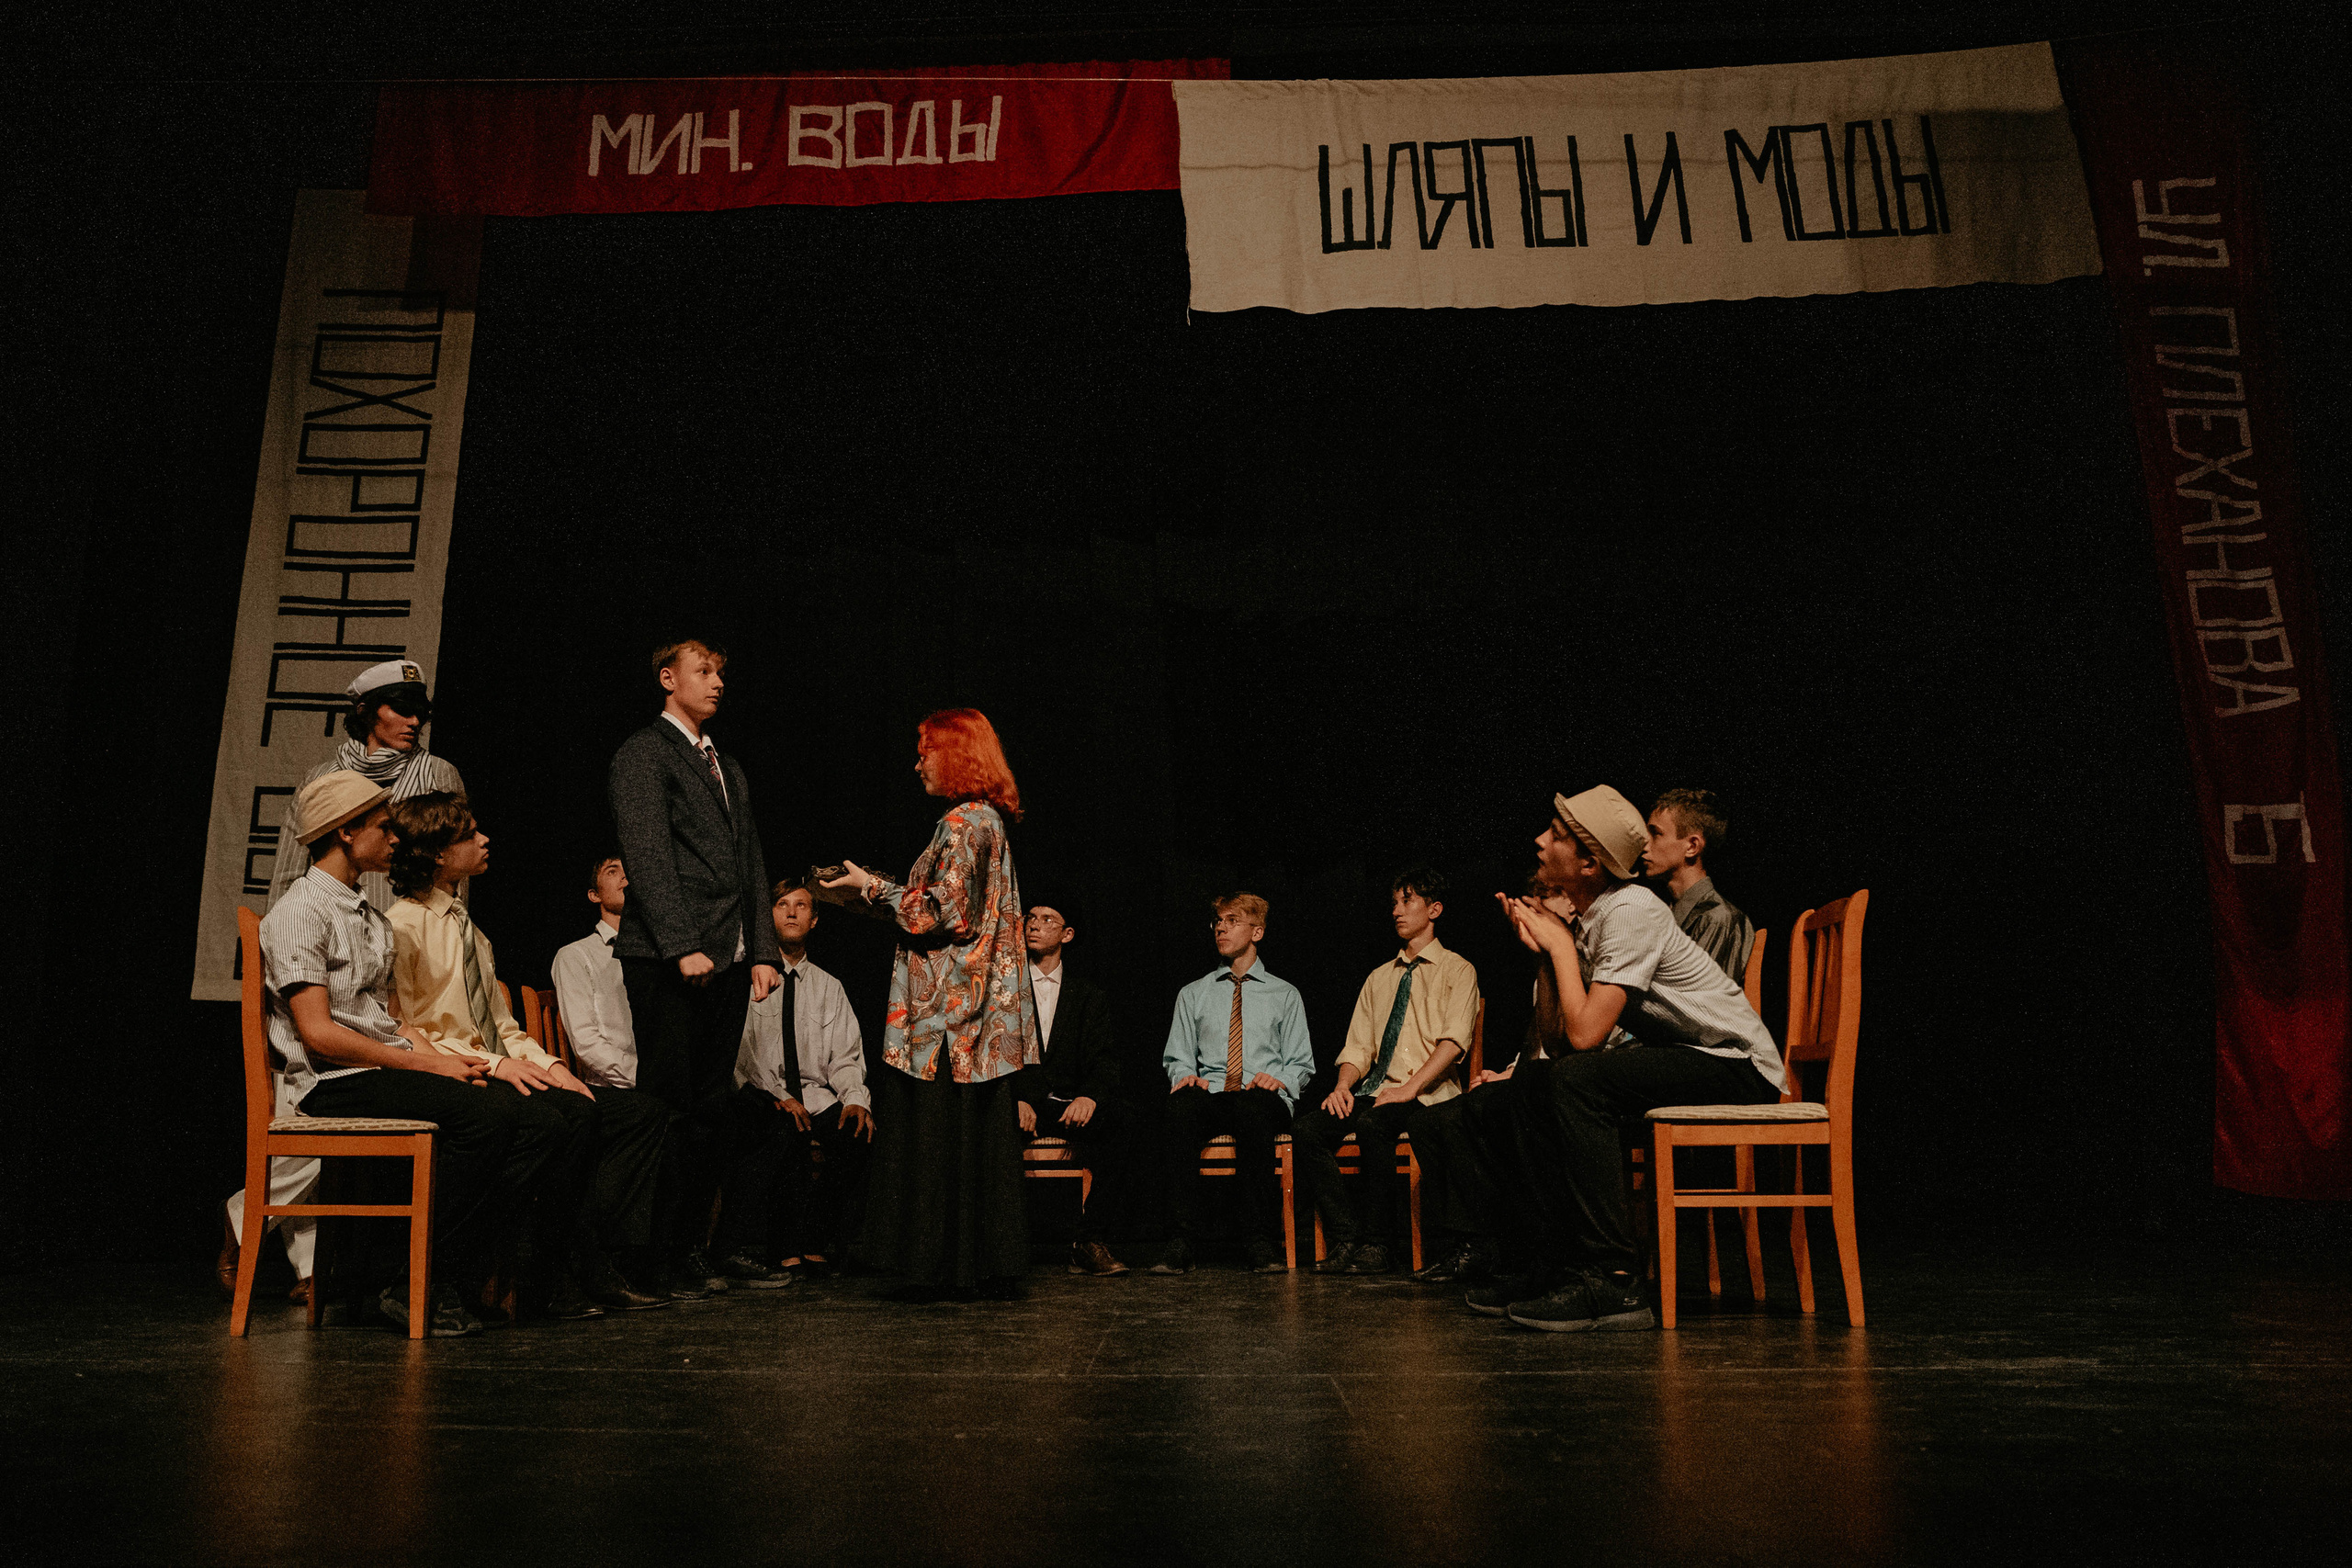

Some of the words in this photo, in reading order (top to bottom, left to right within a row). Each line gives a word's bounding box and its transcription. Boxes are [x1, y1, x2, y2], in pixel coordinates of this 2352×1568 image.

[588, 108, 753, 176] МИН.
[788, 95, 1002, 169] ВОДЫ
[1318, 135, 1588, 254] ШЛЯПЫ
[1624, 131, 1693, 246] И
[1724, 116, 1951, 244] МОДЫ
[2132, 177, 2230, 276] УЛ.
[2149, 306, 2300, 718] ПЛЕХАНОВА
